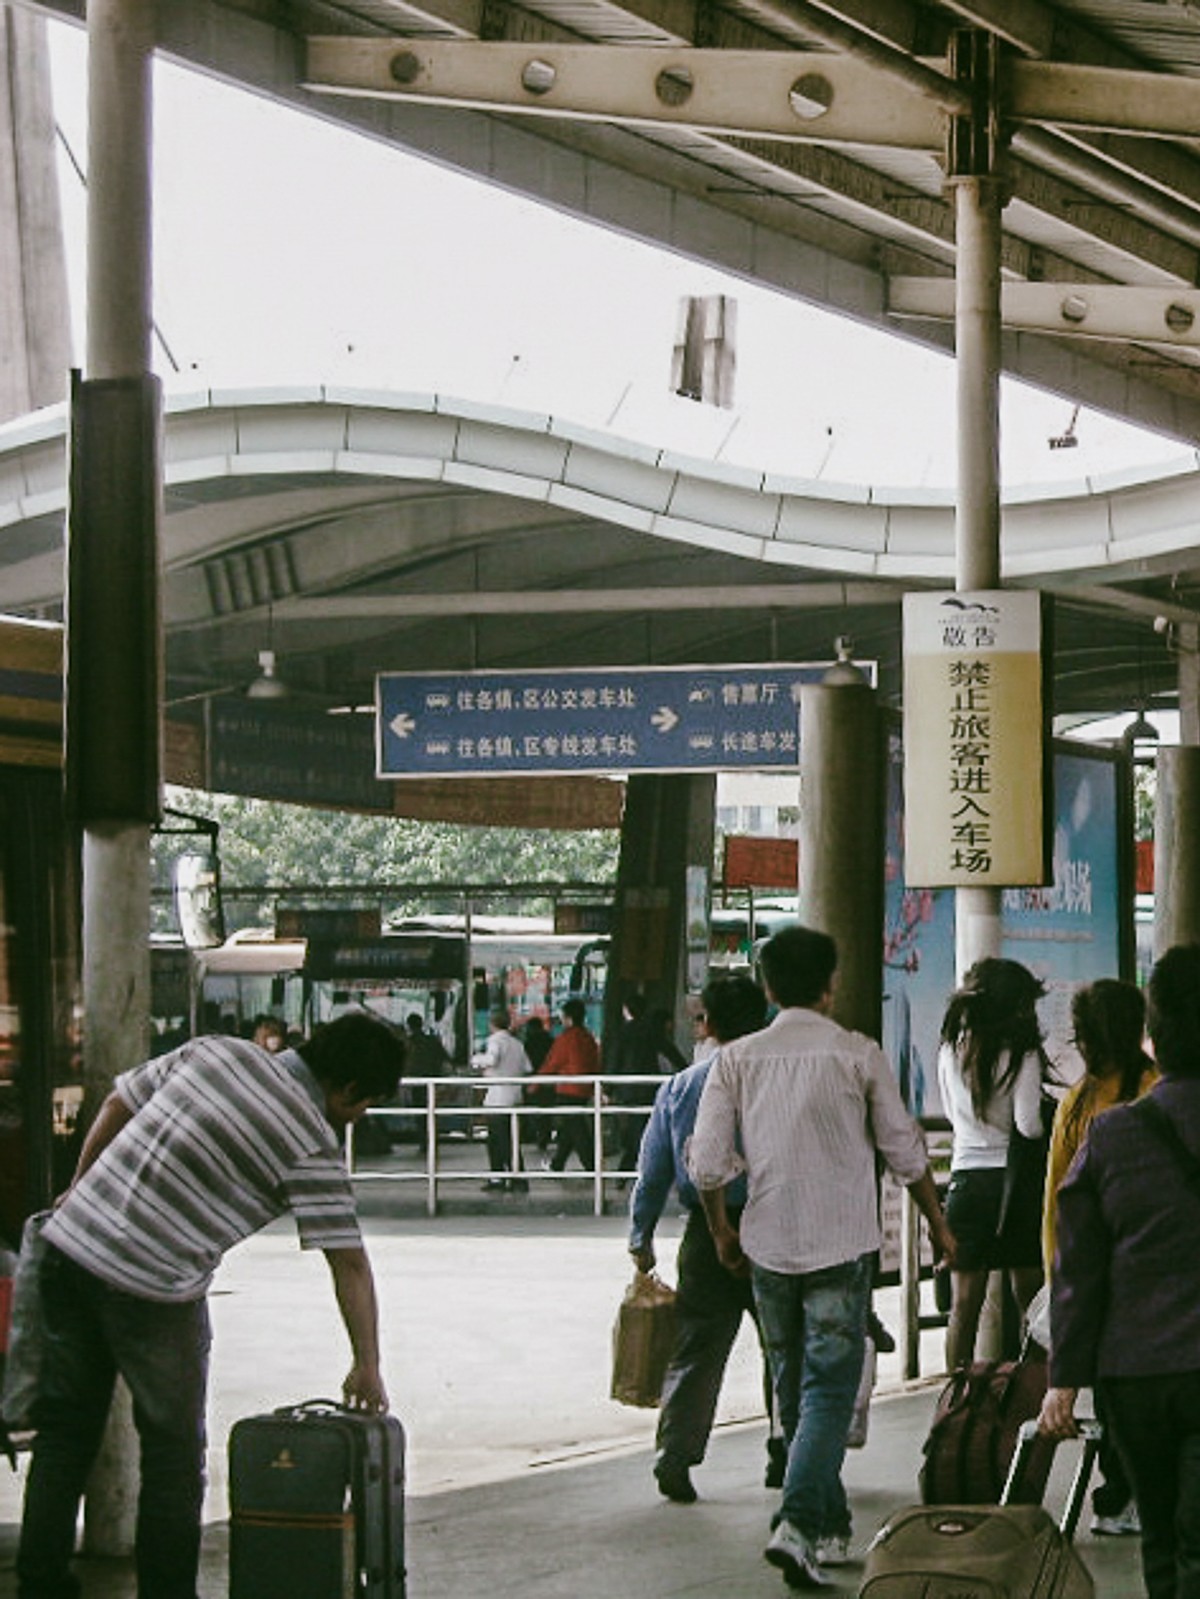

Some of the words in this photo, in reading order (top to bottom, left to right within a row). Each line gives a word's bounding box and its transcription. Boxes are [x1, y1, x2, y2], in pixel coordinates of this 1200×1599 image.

[942, 625, 998, 647] 敬告
[949, 660, 992, 873] 禁止旅客进入车场
